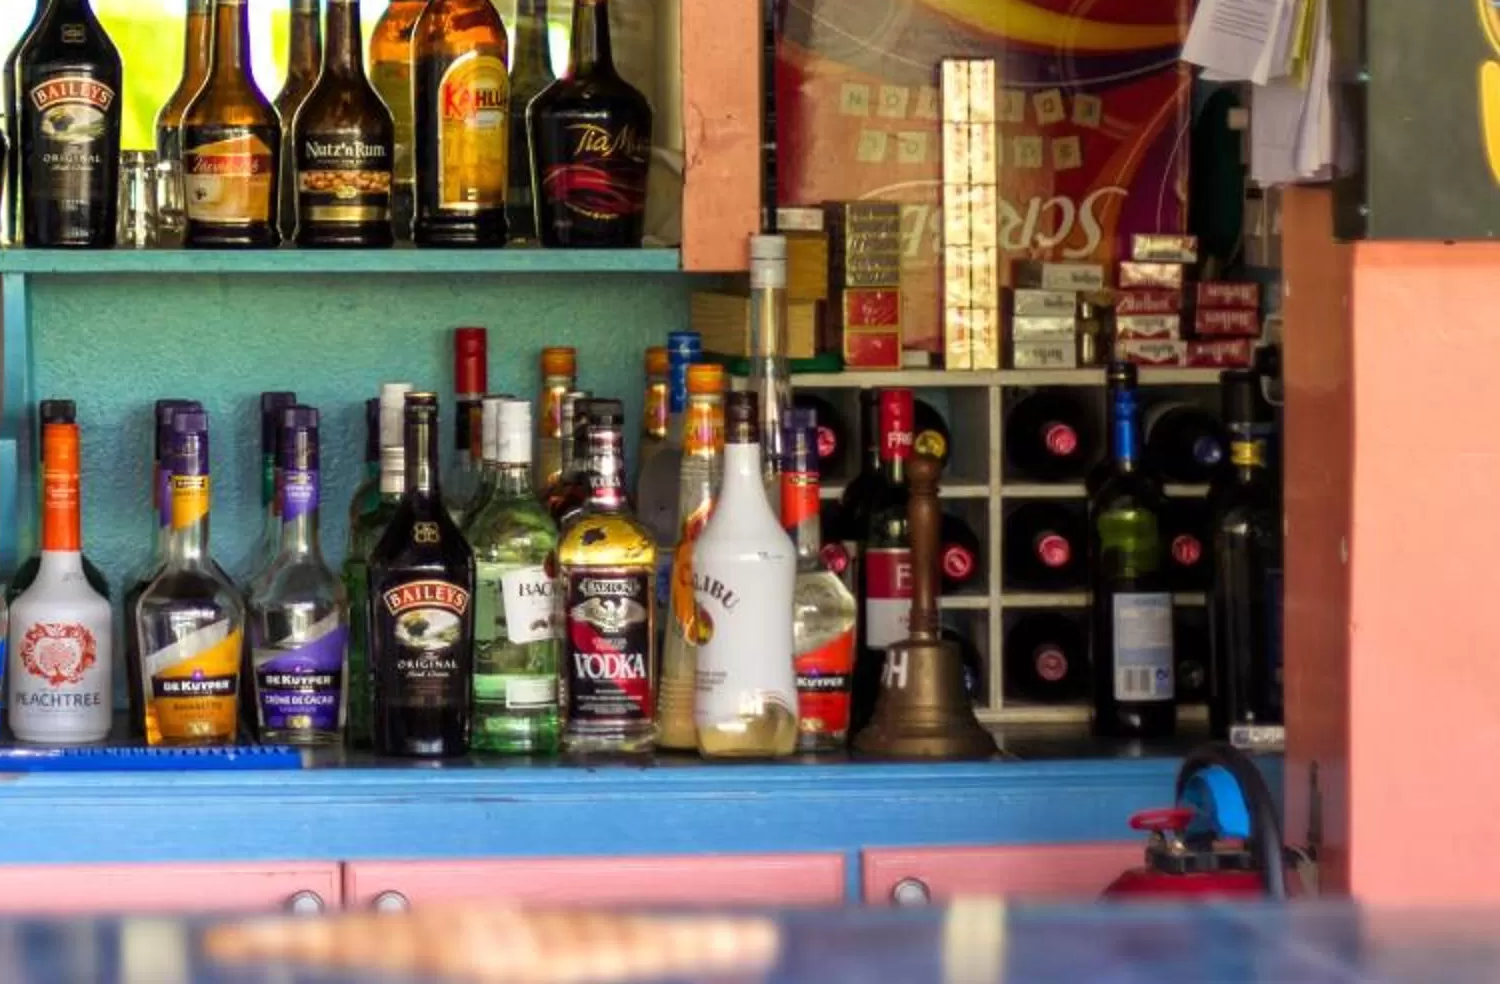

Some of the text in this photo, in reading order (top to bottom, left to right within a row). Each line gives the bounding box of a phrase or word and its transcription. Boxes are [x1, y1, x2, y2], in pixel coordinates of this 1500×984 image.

[36, 80, 108, 103] BAILEYS
[389, 583, 465, 607] BAILEYS
[694, 574, 741, 610] LIBU
[573, 653, 646, 679] VODKA
[14, 691, 101, 708] PEACHTREE
